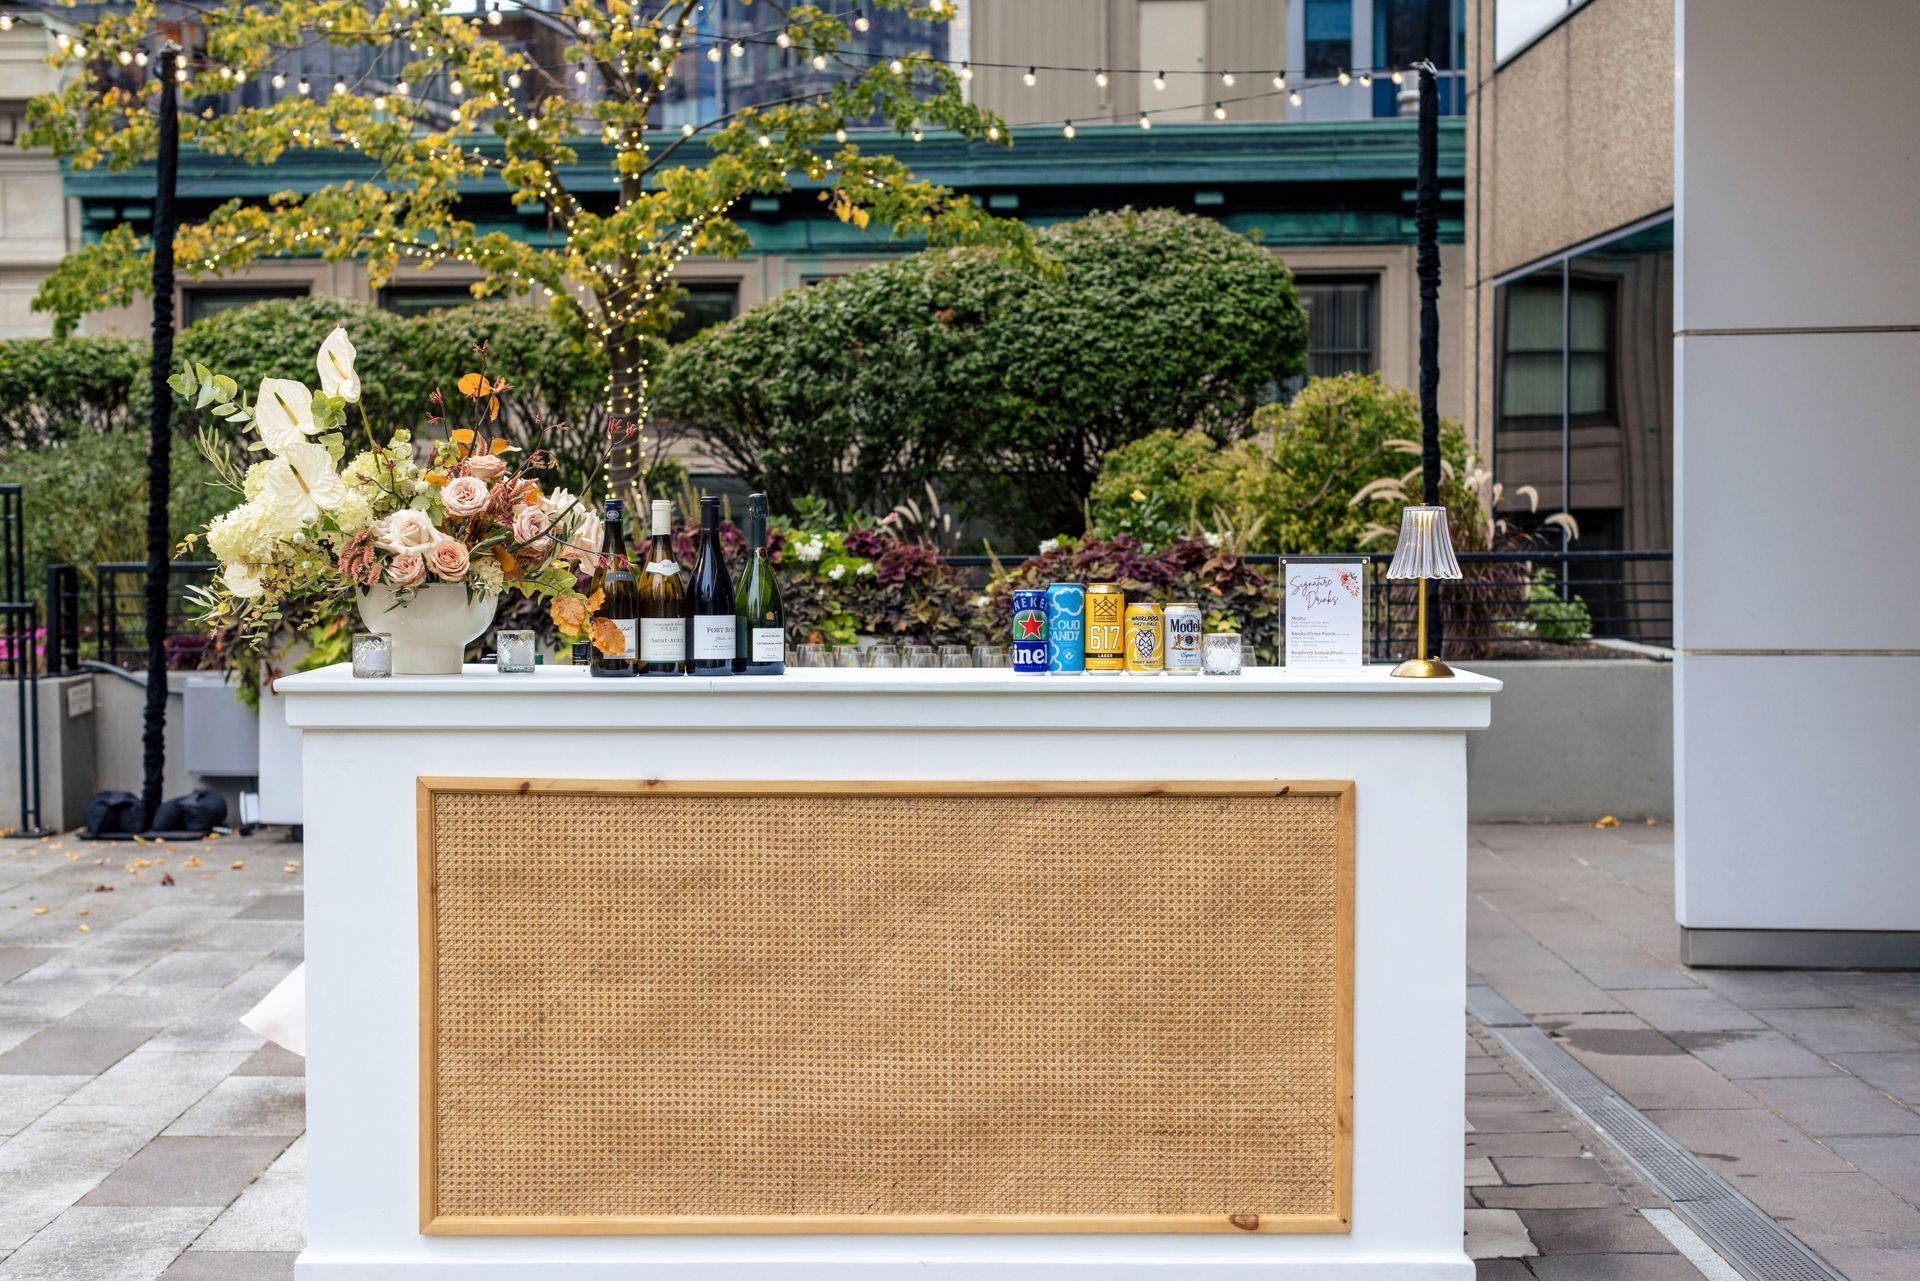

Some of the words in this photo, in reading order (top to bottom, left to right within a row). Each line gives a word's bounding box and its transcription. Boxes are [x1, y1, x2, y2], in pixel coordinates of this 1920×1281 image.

[1290, 575, 1333, 597] Signature
[1306, 590, 1338, 611] Drinks
[1049, 620, 1081, 630] LOUD
[1049, 630, 1081, 641] ANDY
[1090, 625, 1121, 651] 617
